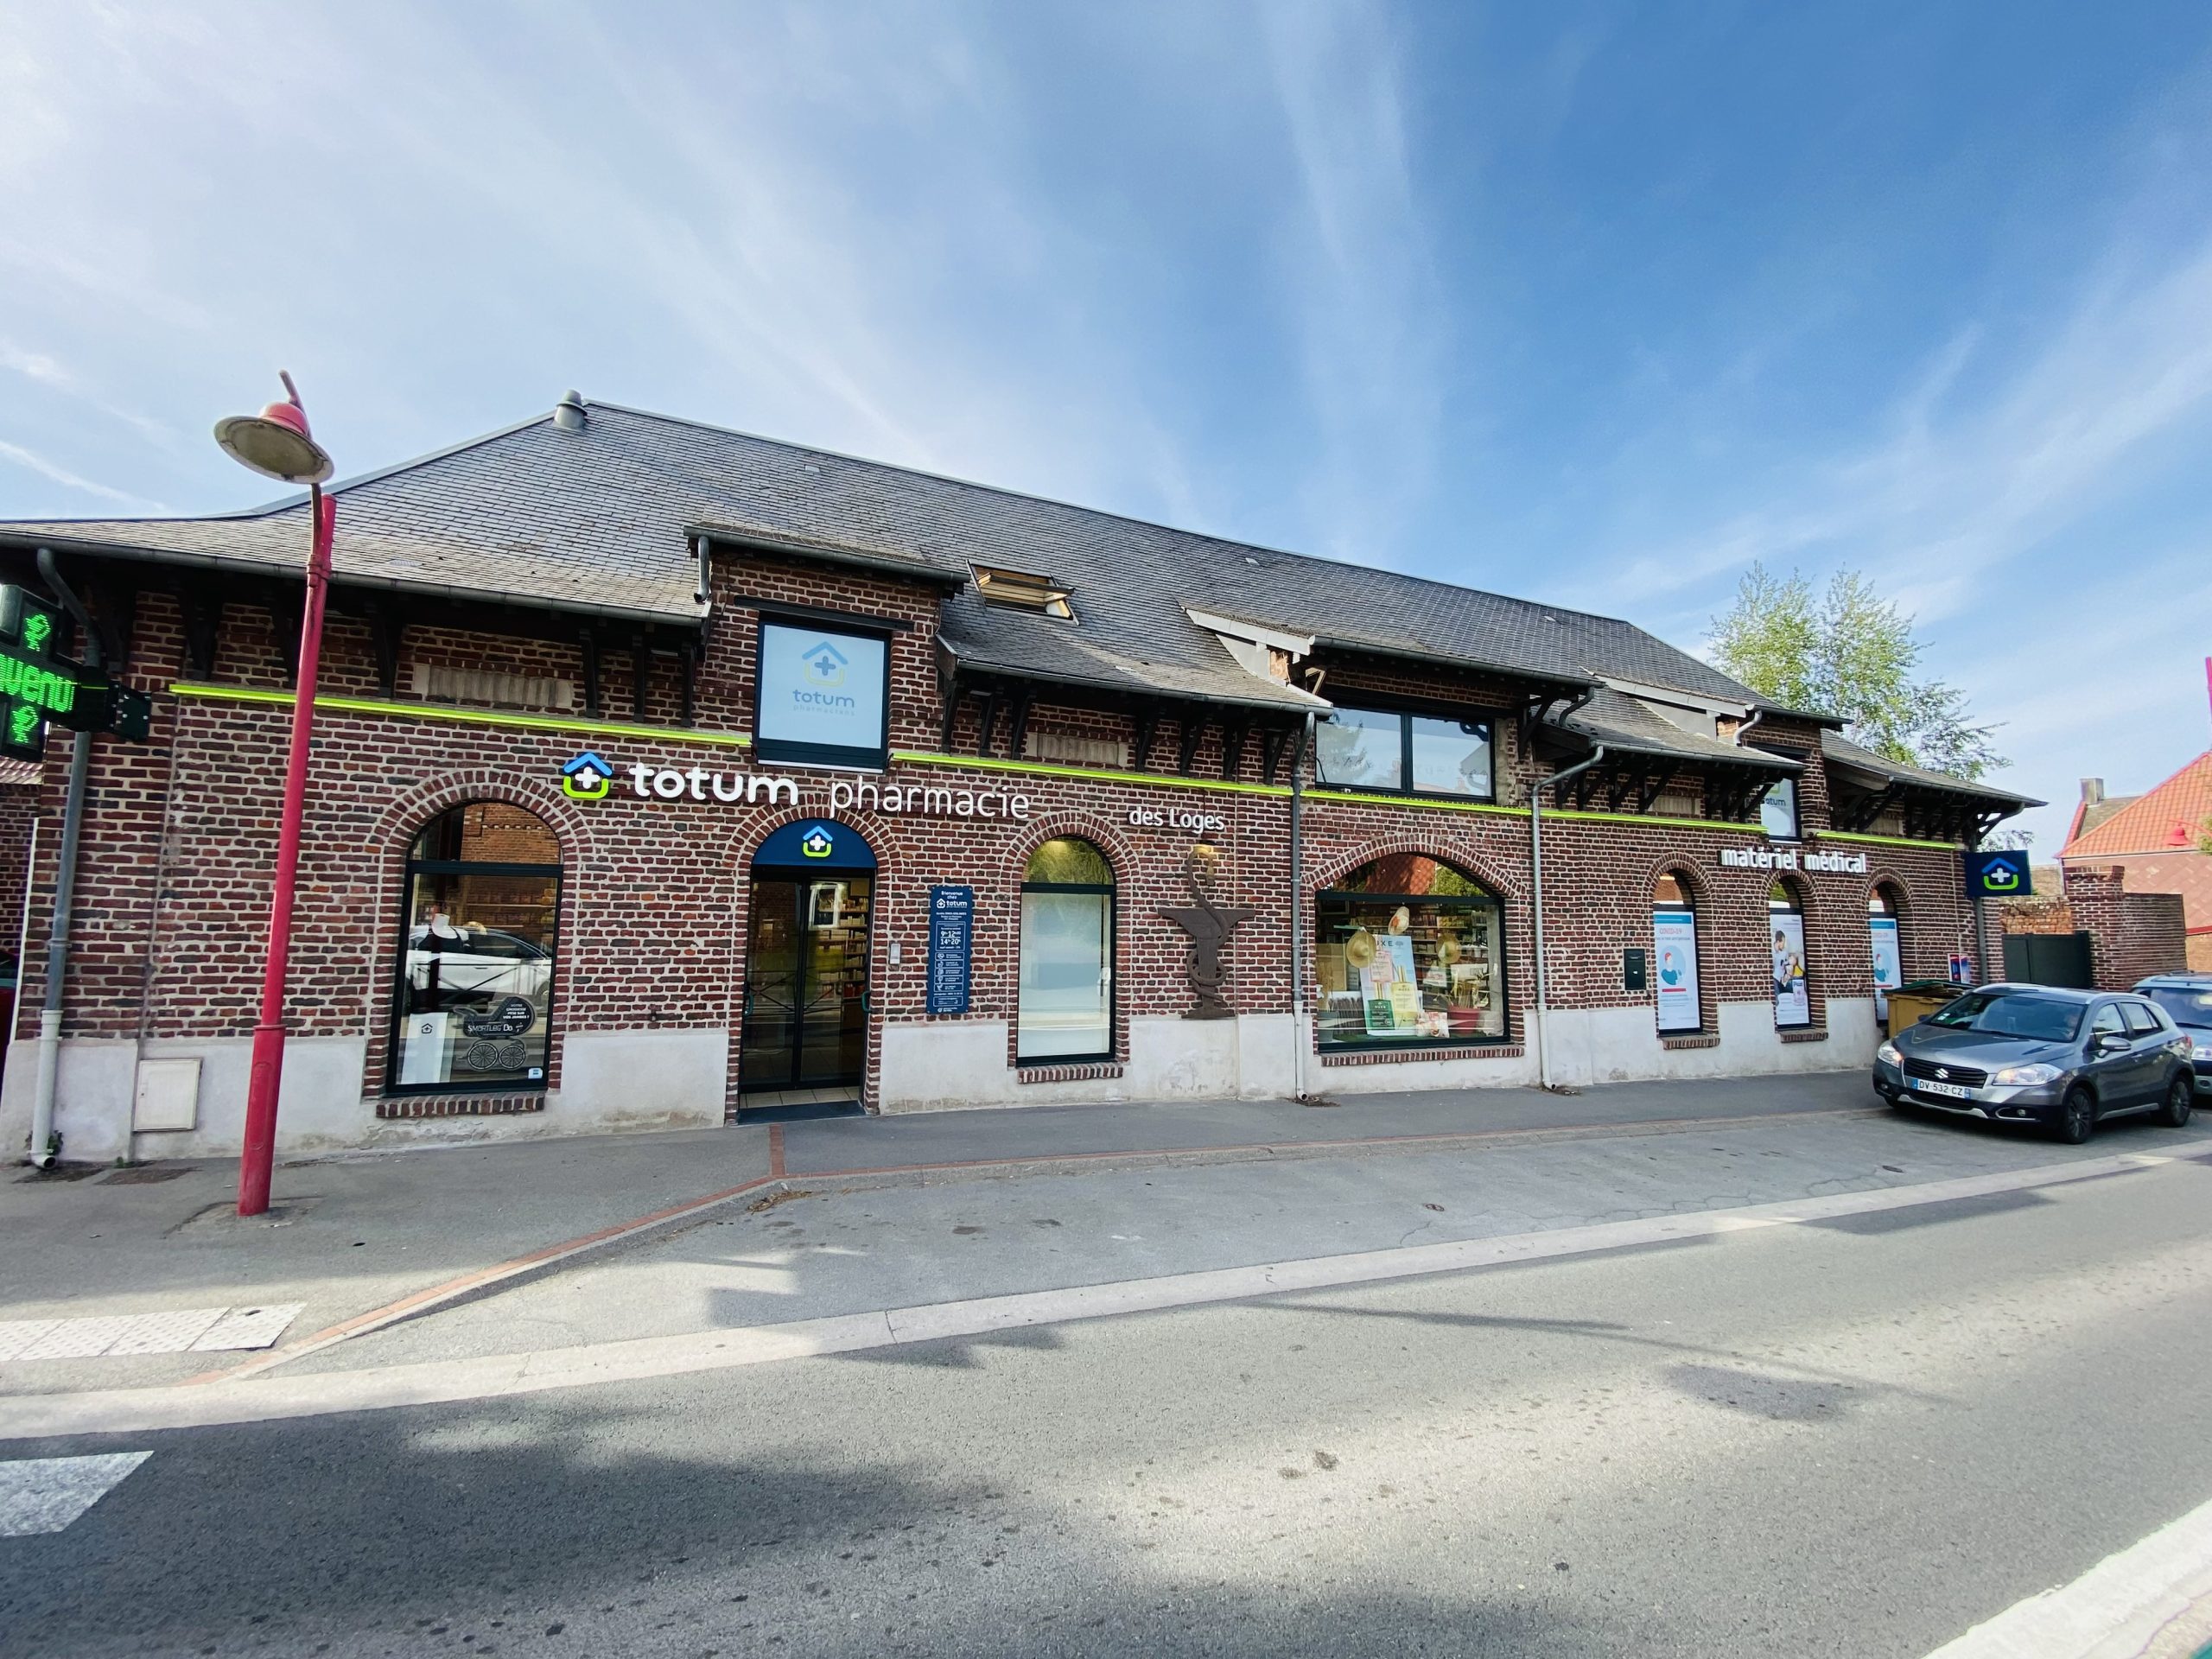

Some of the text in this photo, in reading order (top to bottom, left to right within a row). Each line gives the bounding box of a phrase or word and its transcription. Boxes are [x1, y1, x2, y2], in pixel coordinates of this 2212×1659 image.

[792, 689, 855, 709] totum
[629, 761, 1030, 819] totum pharmacie
[1764, 797, 1787, 807] otum
[1128, 805, 1225, 835] des Loges
[1720, 846, 1866, 874] matériel médical
